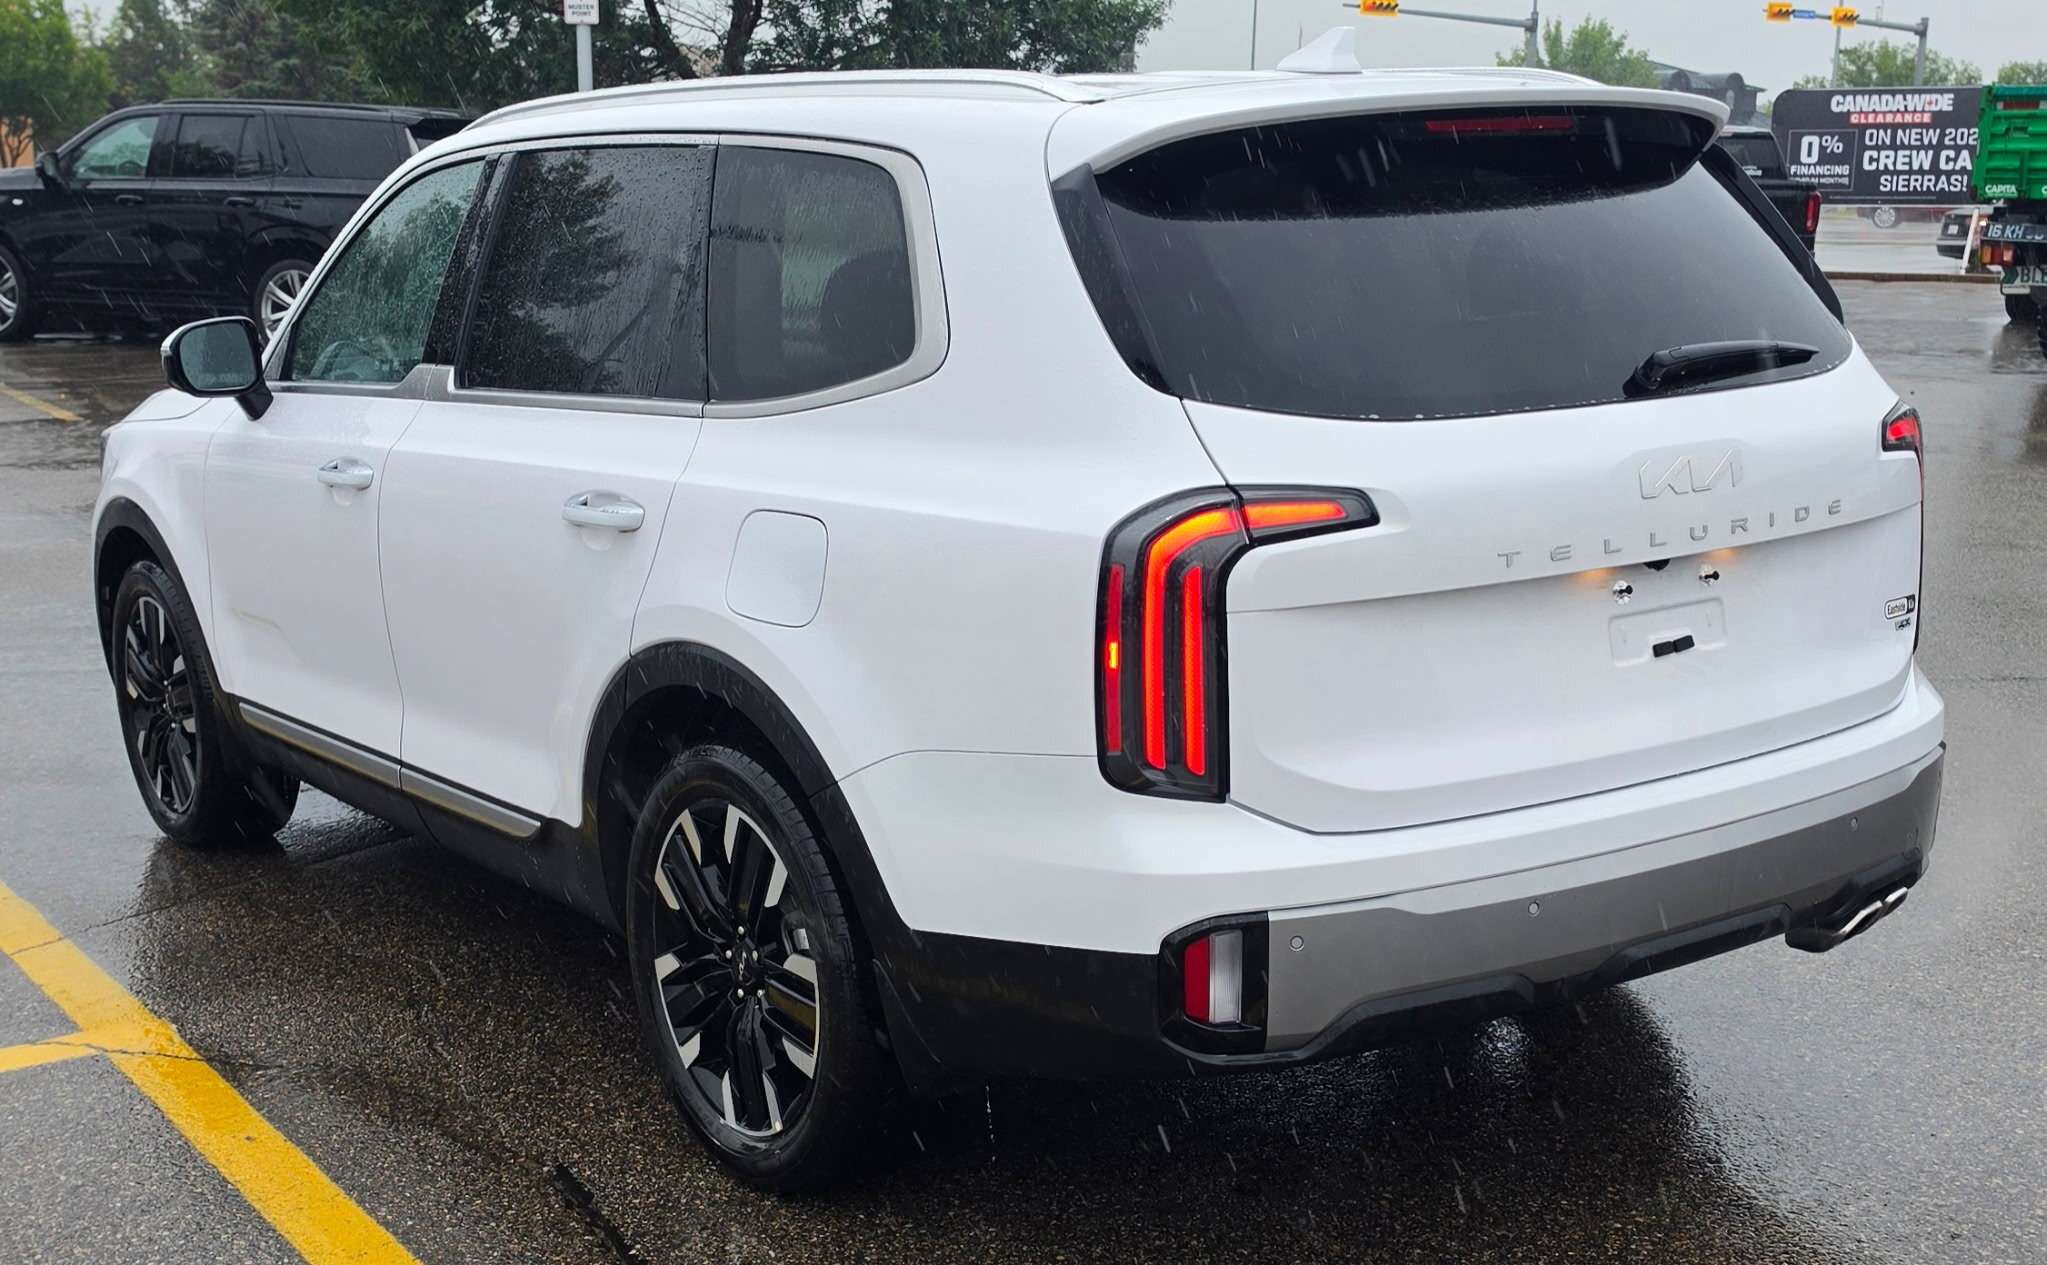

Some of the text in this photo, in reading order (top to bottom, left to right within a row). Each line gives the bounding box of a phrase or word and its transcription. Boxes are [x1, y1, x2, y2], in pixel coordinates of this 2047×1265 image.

[1850, 113, 1932, 123] CLEARANCE
[1865, 128, 1891, 146] ON
[1897, 128, 1940, 146] NEW
[1863, 149, 1934, 171] CREW
[1790, 164, 1850, 176] FINANCING
[1879, 174, 1969, 192] SIERRAS!
[1497, 499, 1842, 569] TELLURIDE
